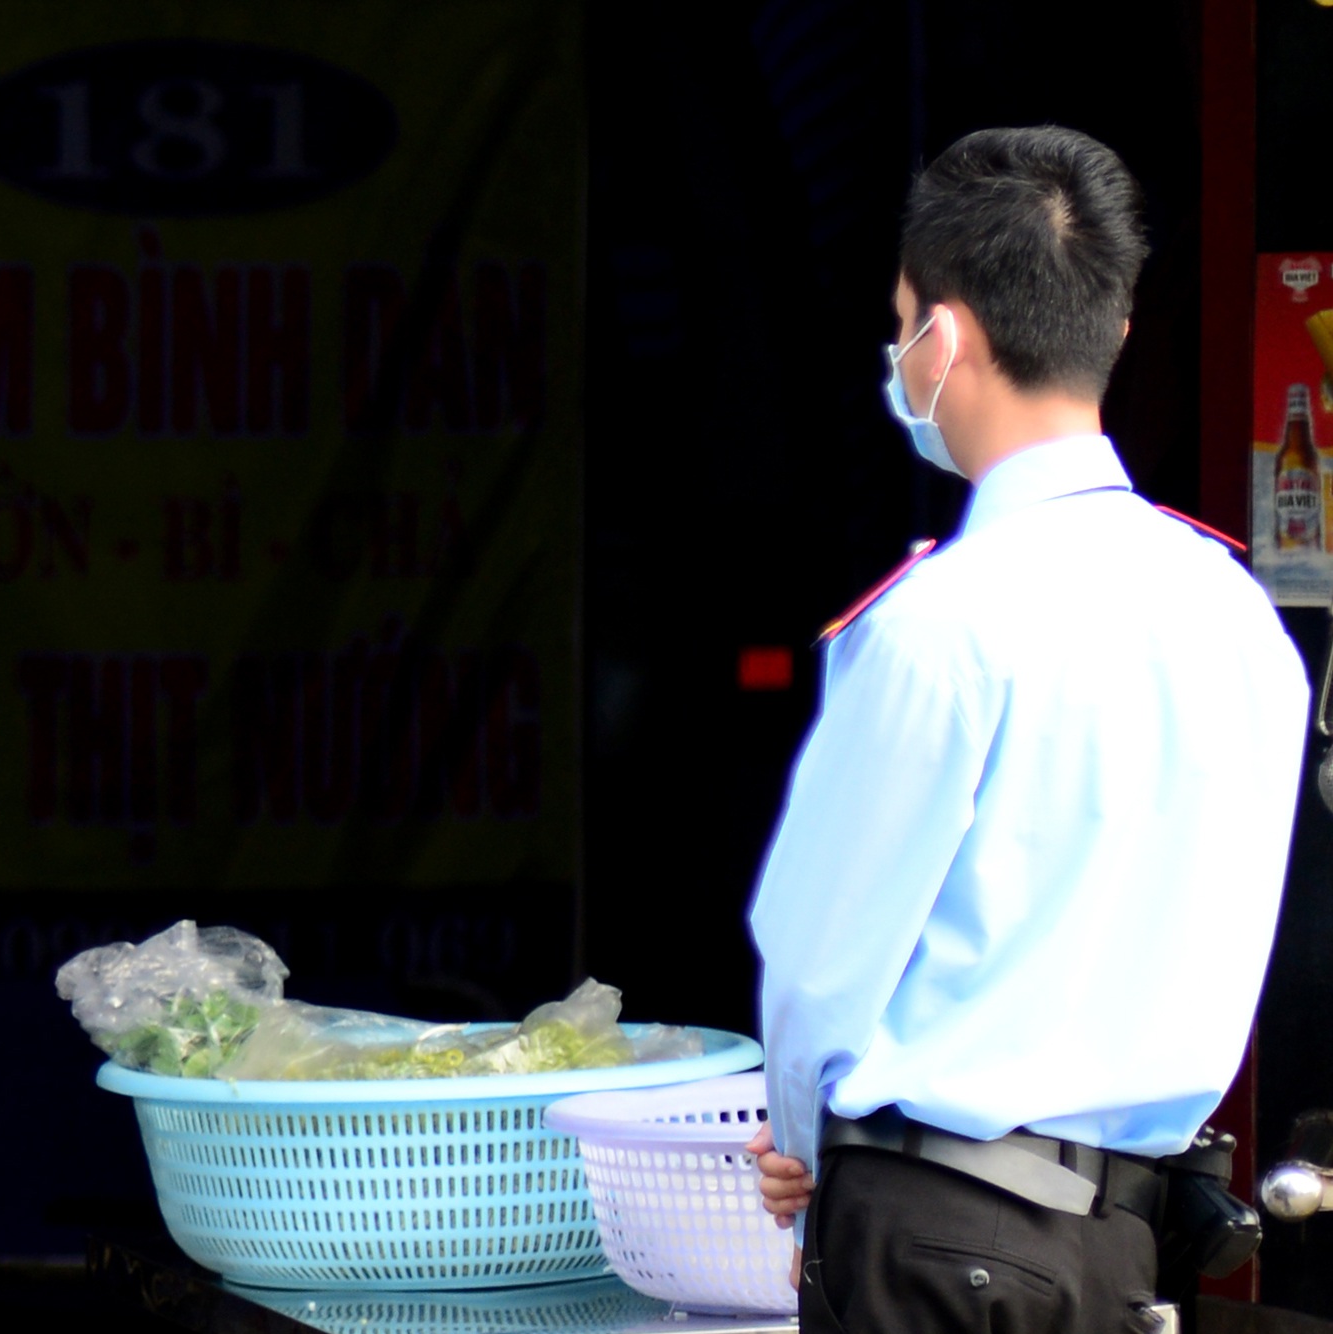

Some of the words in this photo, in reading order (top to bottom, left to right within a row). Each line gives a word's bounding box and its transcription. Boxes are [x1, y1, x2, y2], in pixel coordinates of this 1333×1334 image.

[37, 77, 323, 181] 181
[65, 222, 312, 438] BÌNH
[18, 651, 208, 866] THỊT
